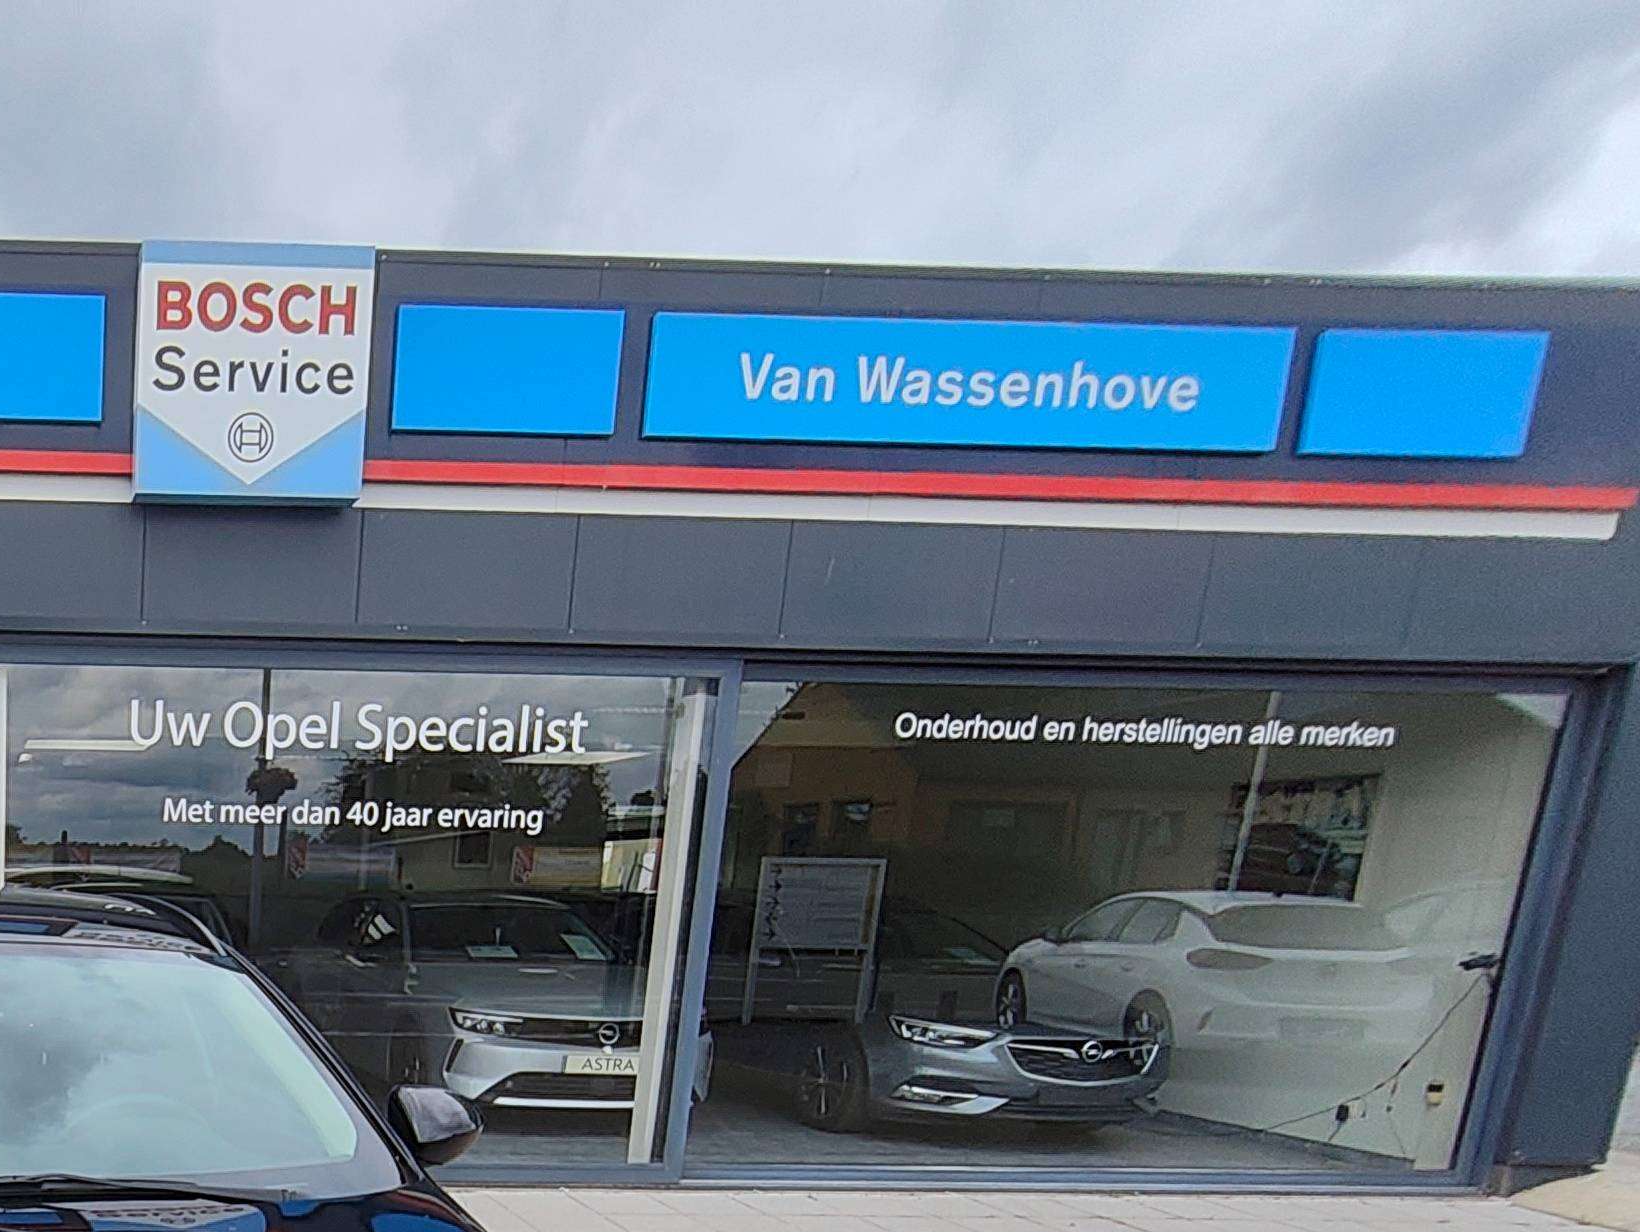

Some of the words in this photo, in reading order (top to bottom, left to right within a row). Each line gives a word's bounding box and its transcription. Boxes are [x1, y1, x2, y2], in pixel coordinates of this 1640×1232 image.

[156, 280, 358, 336] BOSCH
[152, 345, 355, 395] Service
[740, 351, 835, 402] Van
[857, 355, 1200, 412] Wassenhove
[129, 699, 211, 747] Uw
[223, 700, 340, 761] Opel
[354, 702, 590, 763] Specialist
[894, 711, 1039, 742] Onderhoud
[1042, 721, 1075, 742] en
[1081, 715, 1243, 750] herstellingen
[1247, 720, 1294, 746] alle
[1299, 720, 1396, 748] merken
[162, 798, 214, 824] Met
[219, 803, 287, 825] meer
[291, 799, 341, 827] dan
[346, 801, 380, 827] 40
[381, 802, 434, 832] jaar
[436, 803, 544, 835] ervaring
[581, 1058, 635, 1071] ASTRA
